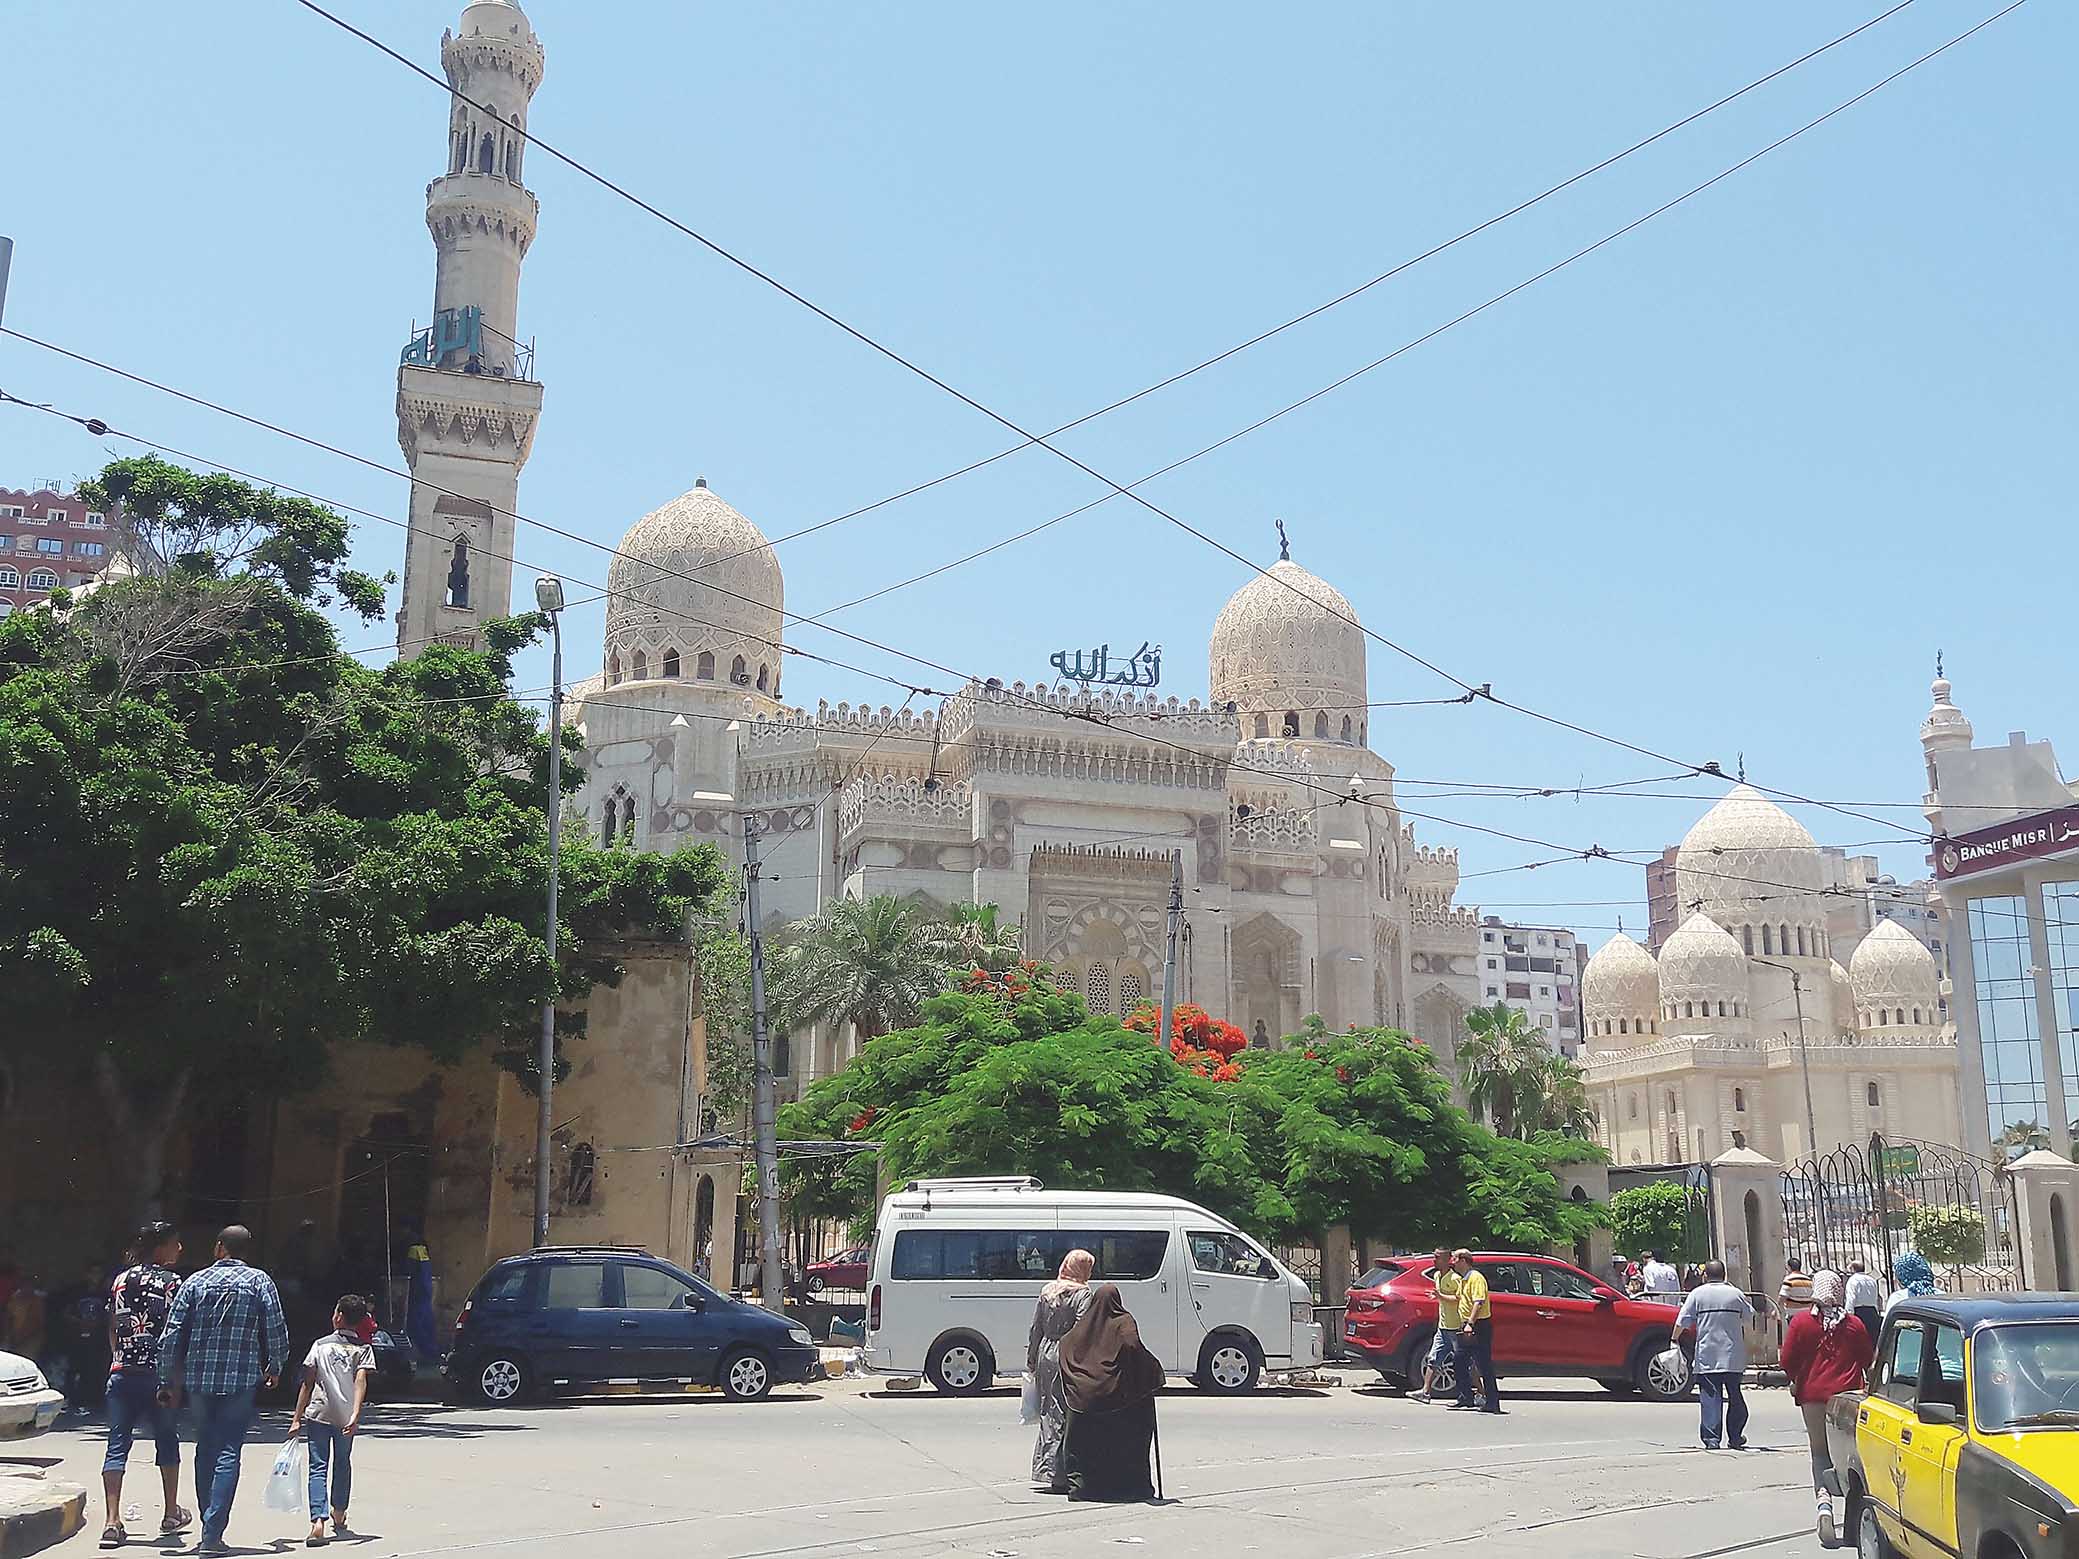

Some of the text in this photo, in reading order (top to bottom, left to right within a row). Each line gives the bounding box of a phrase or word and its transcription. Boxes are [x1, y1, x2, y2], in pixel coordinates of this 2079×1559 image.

[1050, 644, 1108, 680] الله
[1960, 840, 2010, 861] BANQUE
[2012, 829, 2047, 848] MISR
